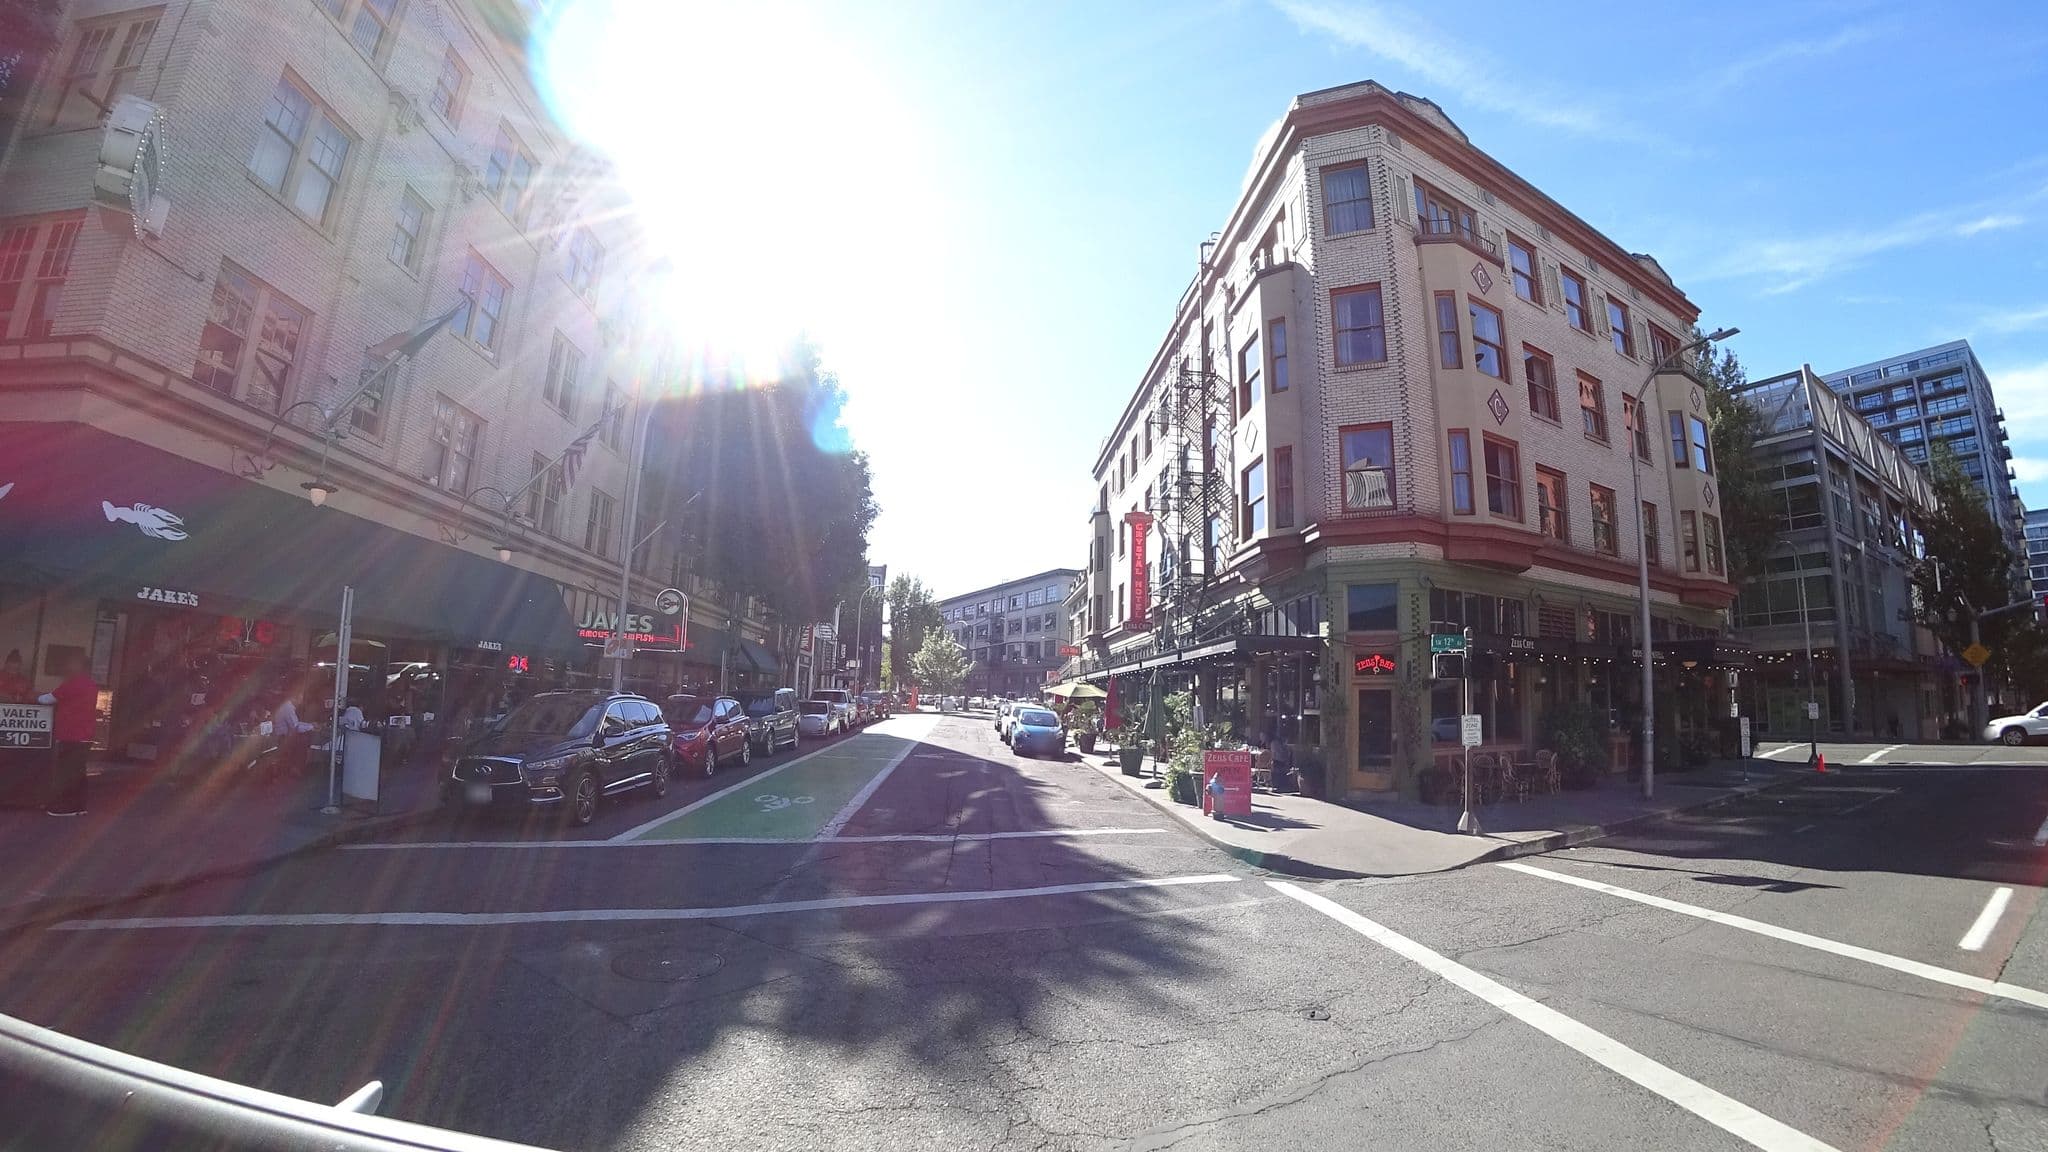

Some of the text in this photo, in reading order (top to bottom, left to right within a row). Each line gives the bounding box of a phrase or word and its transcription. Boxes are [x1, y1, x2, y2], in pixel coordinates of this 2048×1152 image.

[1135, 523, 1143, 575] CRYSTAL
[137, 586, 199, 607] JAKE'S
[3, 708, 40, 719] VALET
[0, 719, 47, 729] ARKING
[5, 732, 31, 746] $10
